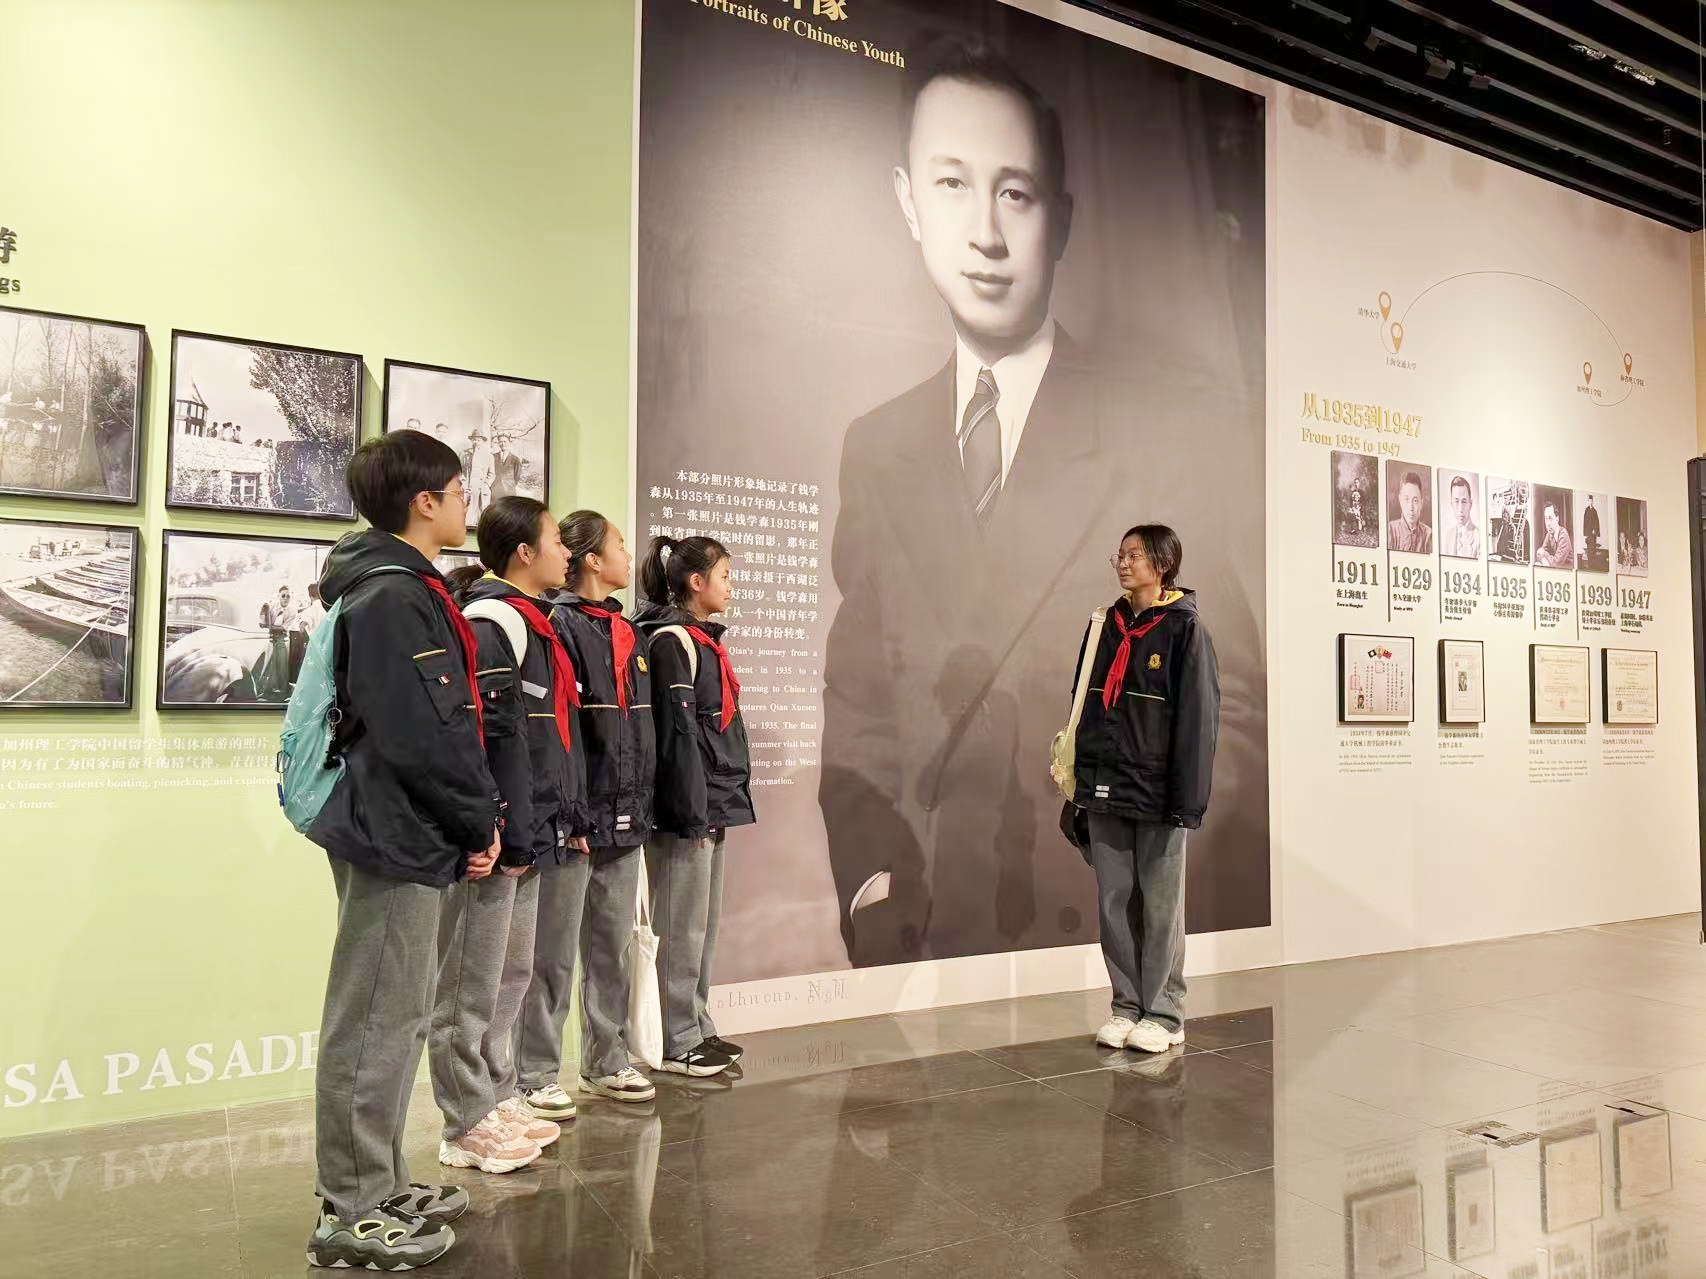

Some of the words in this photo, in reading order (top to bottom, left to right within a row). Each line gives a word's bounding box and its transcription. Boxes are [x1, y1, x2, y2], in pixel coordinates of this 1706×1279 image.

[773, 16, 790, 32] of
[793, 20, 858, 53] Chinese
[861, 40, 905, 69] Youth
[1301, 392, 1422, 437] 从1935到1947
[1301, 428, 1332, 446] From
[1336, 434, 1360, 451] 1935
[1363, 440, 1373, 453] to
[1377, 442, 1400, 457] 1947
[677, 470, 819, 497] 本部分照片形象地记录了钱学
[650, 486, 819, 515] 森从1935年至1947年的人生轨迹
[728, 549, 819, 569] 一张照片是钱学森
[1337, 560, 1379, 586] 1911
[1392, 565, 1433, 591] 1929
[1444, 571, 1482, 596] 1934
[1492, 575, 1528, 600] 1935
[1537, 580, 1571, 603] 1936
[1580, 584, 1613, 607] 1939
[1621, 588, 1652, 610] 1947
[729, 647, 754, 656] Qian's
[757, 648, 787, 658] journey
[791, 649, 809, 657] from
[760, 665, 768, 674] in
[772, 685, 780, 693] to
[784, 684, 806, 693] China
[810, 685, 817, 693] in
[770, 702, 788, 712] Qian
[791, 703, 817, 712] Xuesen
[749, 721, 757, 730] in
[761, 721, 780, 730] 1935.
[783, 721, 798, 730] The
[800, 721, 817, 730] final
[751, 740, 781, 748] summer
[783, 739, 798, 748] visit
[800, 739, 817, 748] back
[773, 759, 782, 767] on
[785, 757, 797, 767] the
[799, 757, 817, 767] West
[8, 779, 54, 789] Chinese
[57, 778, 105, 789] students
[107, 777, 150, 789] boating,
[213, 776, 232, 785] and
[19, 800, 57, 809] future.
[4, 1059, 84, 1107] SA
